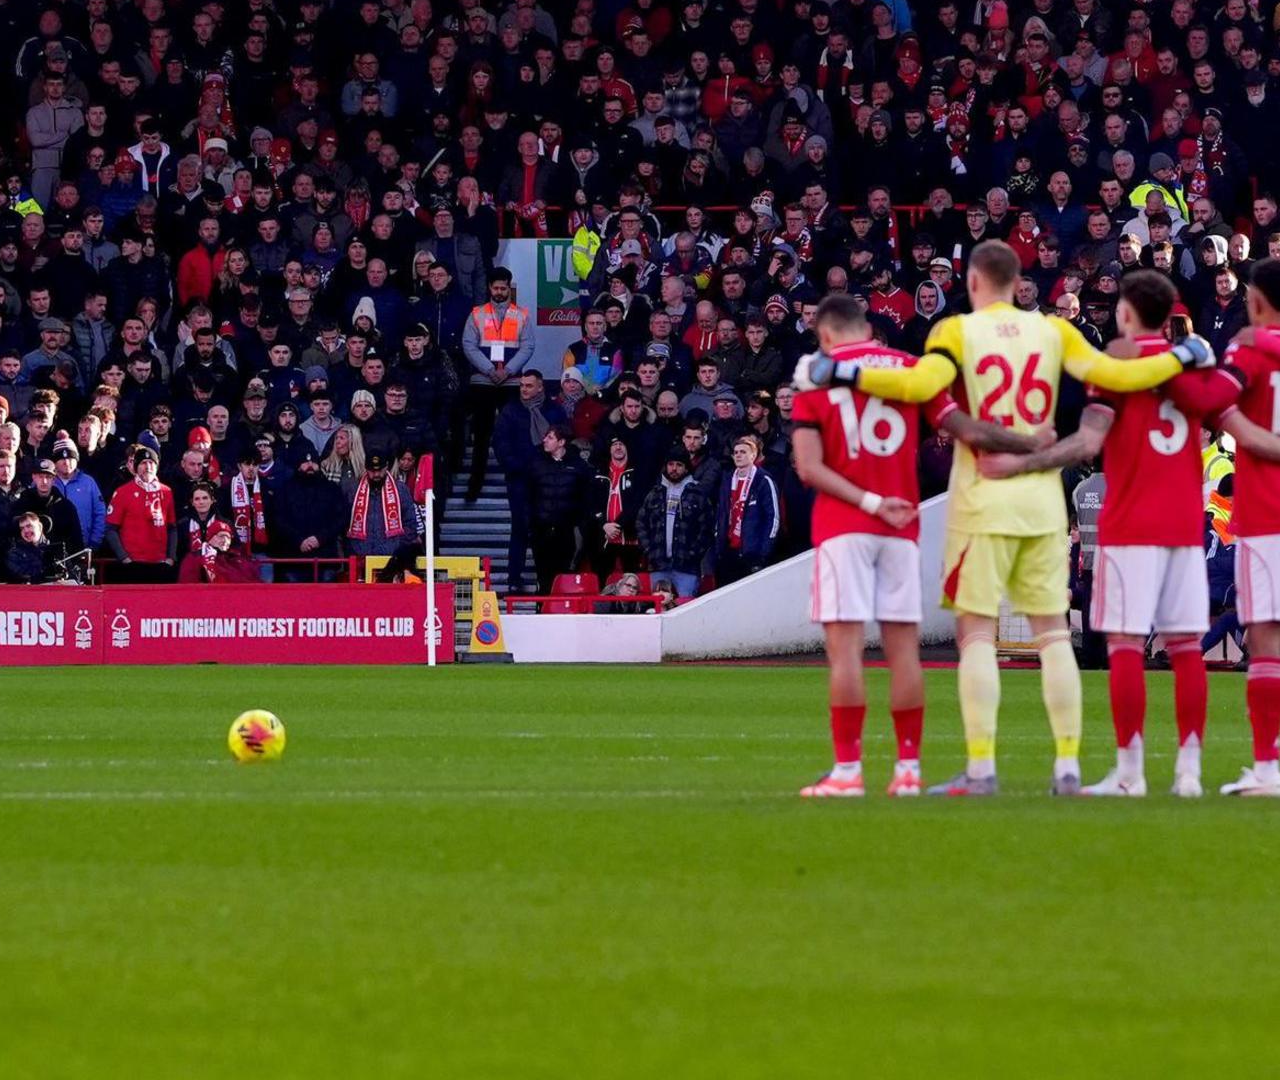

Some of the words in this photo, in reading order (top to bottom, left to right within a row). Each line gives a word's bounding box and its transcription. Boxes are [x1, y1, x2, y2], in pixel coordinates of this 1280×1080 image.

[827, 388, 907, 460] 16
[976, 354, 1053, 426] 26
[140, 617, 236, 638] NOTTINGHAM
[238, 617, 295, 638] FOREST
[298, 617, 373, 638] FOOTBALL
[375, 617, 414, 637] CLUB
